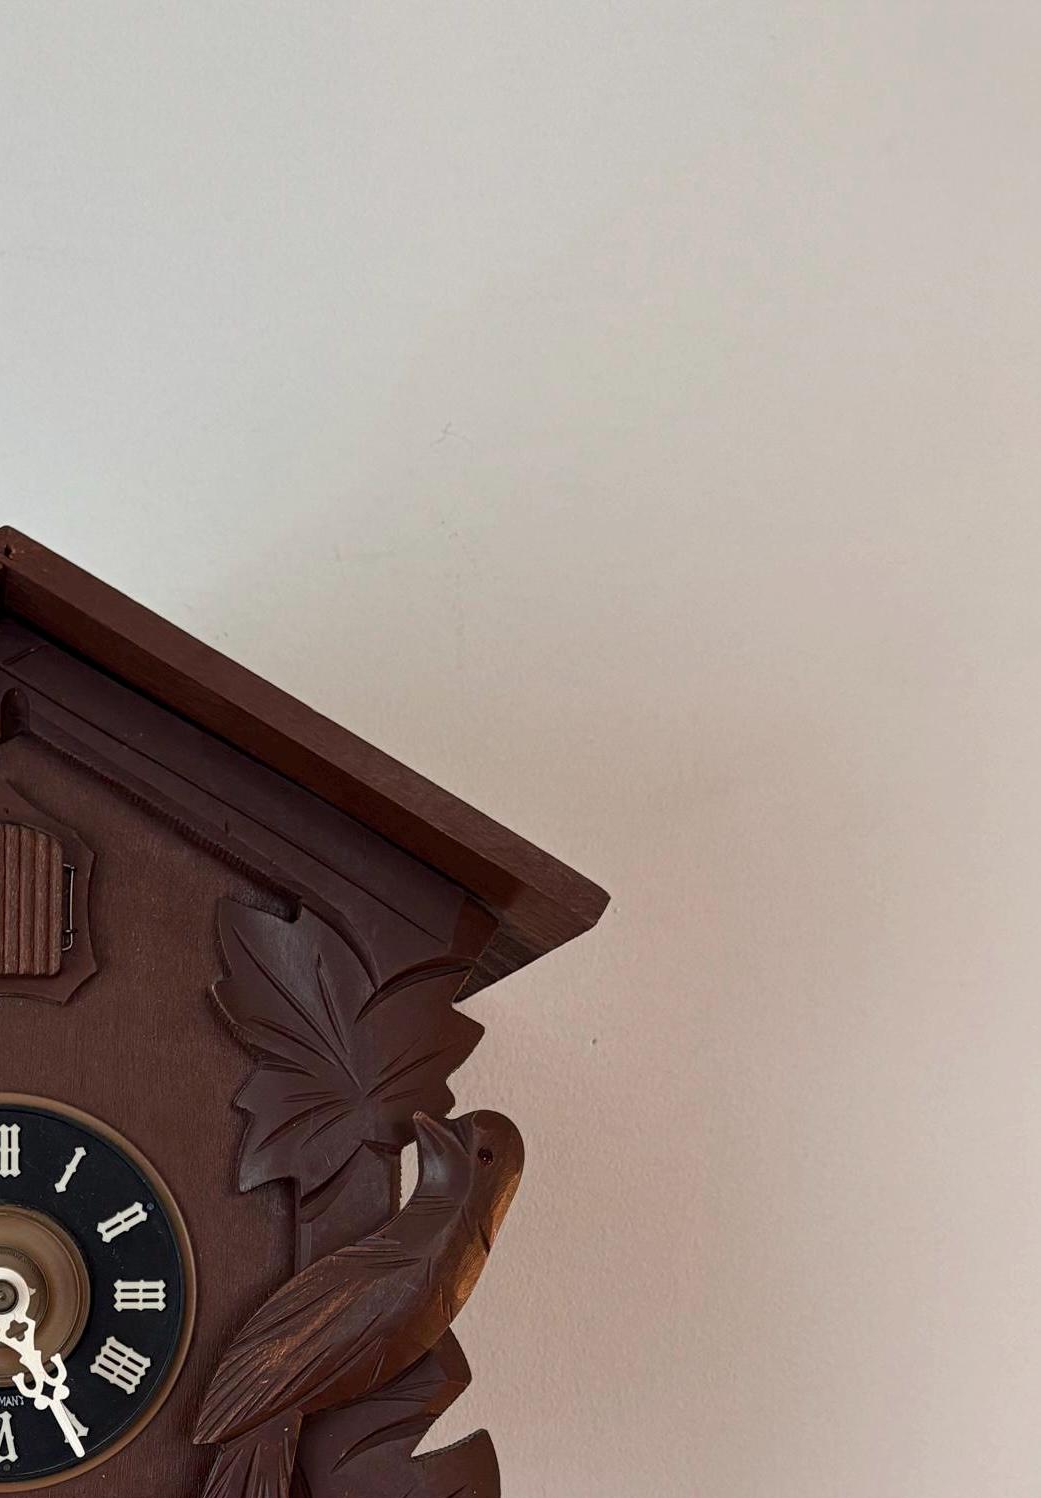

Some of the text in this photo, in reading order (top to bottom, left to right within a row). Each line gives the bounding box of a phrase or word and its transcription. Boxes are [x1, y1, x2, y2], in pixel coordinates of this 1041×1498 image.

[55, 1147, 86, 1192] I
[97, 1202, 147, 1242] II
[114, 1280, 166, 1311] III
[90, 1336, 150, 1394] IIII
